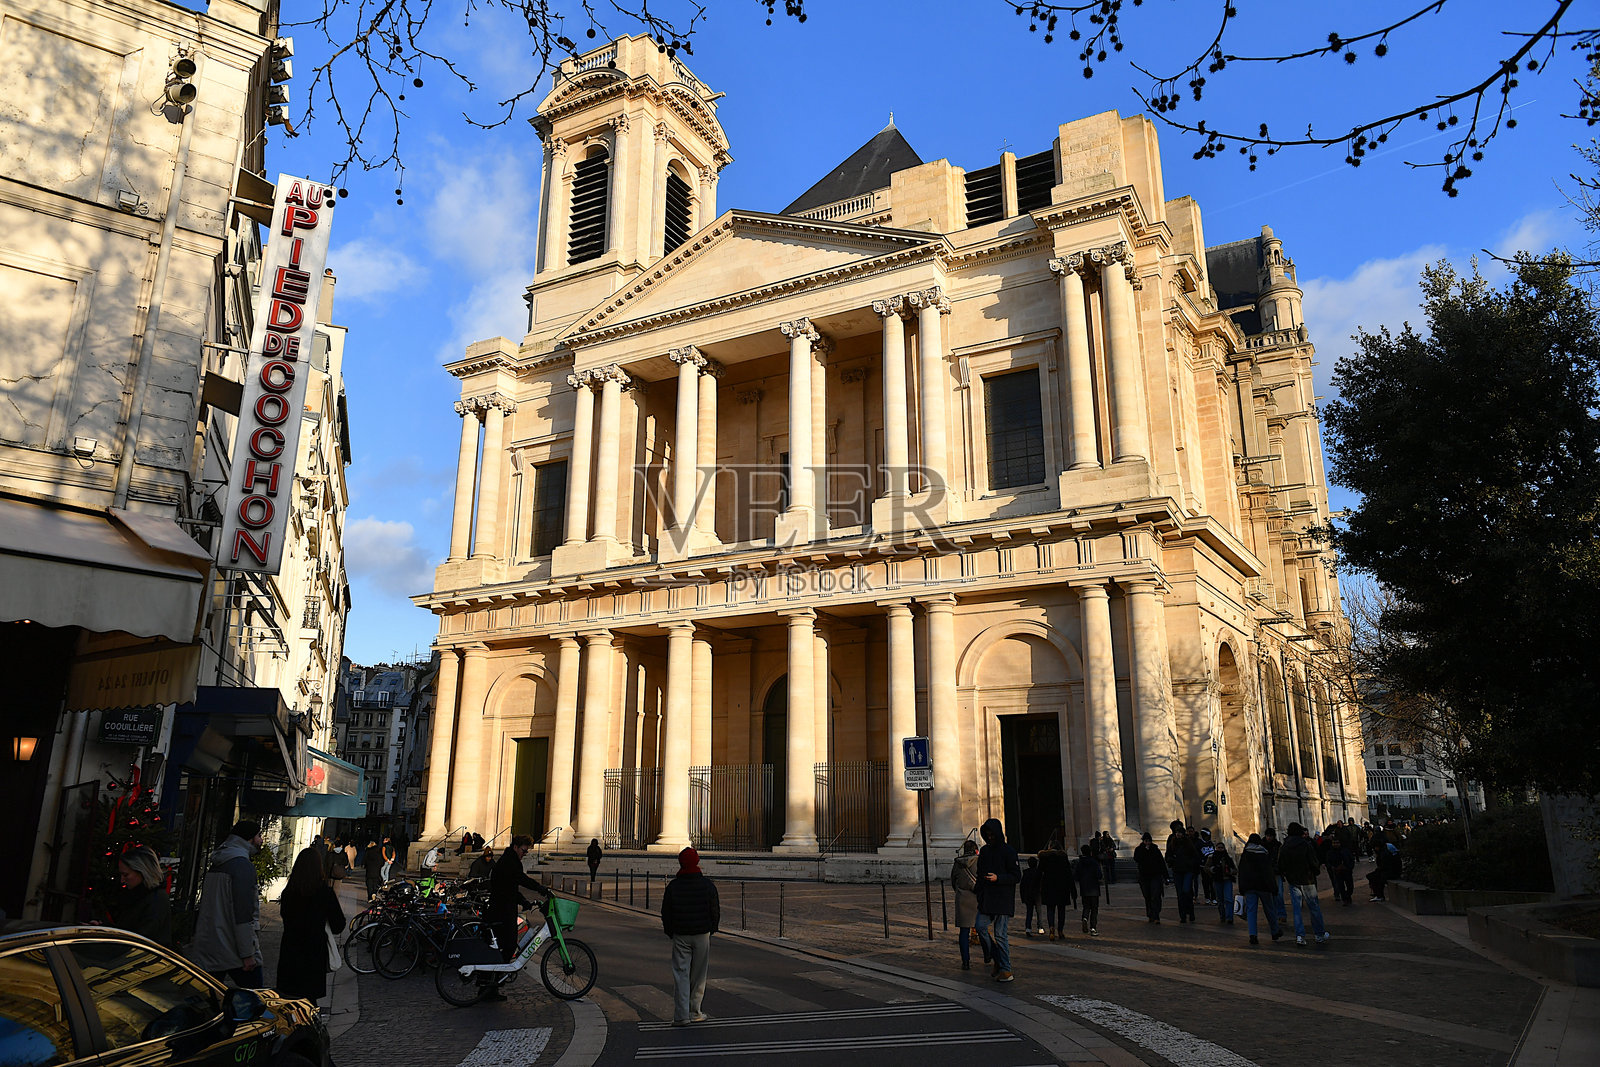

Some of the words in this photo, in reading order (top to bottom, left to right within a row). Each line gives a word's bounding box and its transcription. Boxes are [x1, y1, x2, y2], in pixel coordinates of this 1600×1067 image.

[286, 180, 324, 207] AU
[265, 204, 320, 333] PIED
[262, 330, 300, 361] DE
[230, 359, 295, 566] COCHON
[123, 713, 139, 721] RUE
